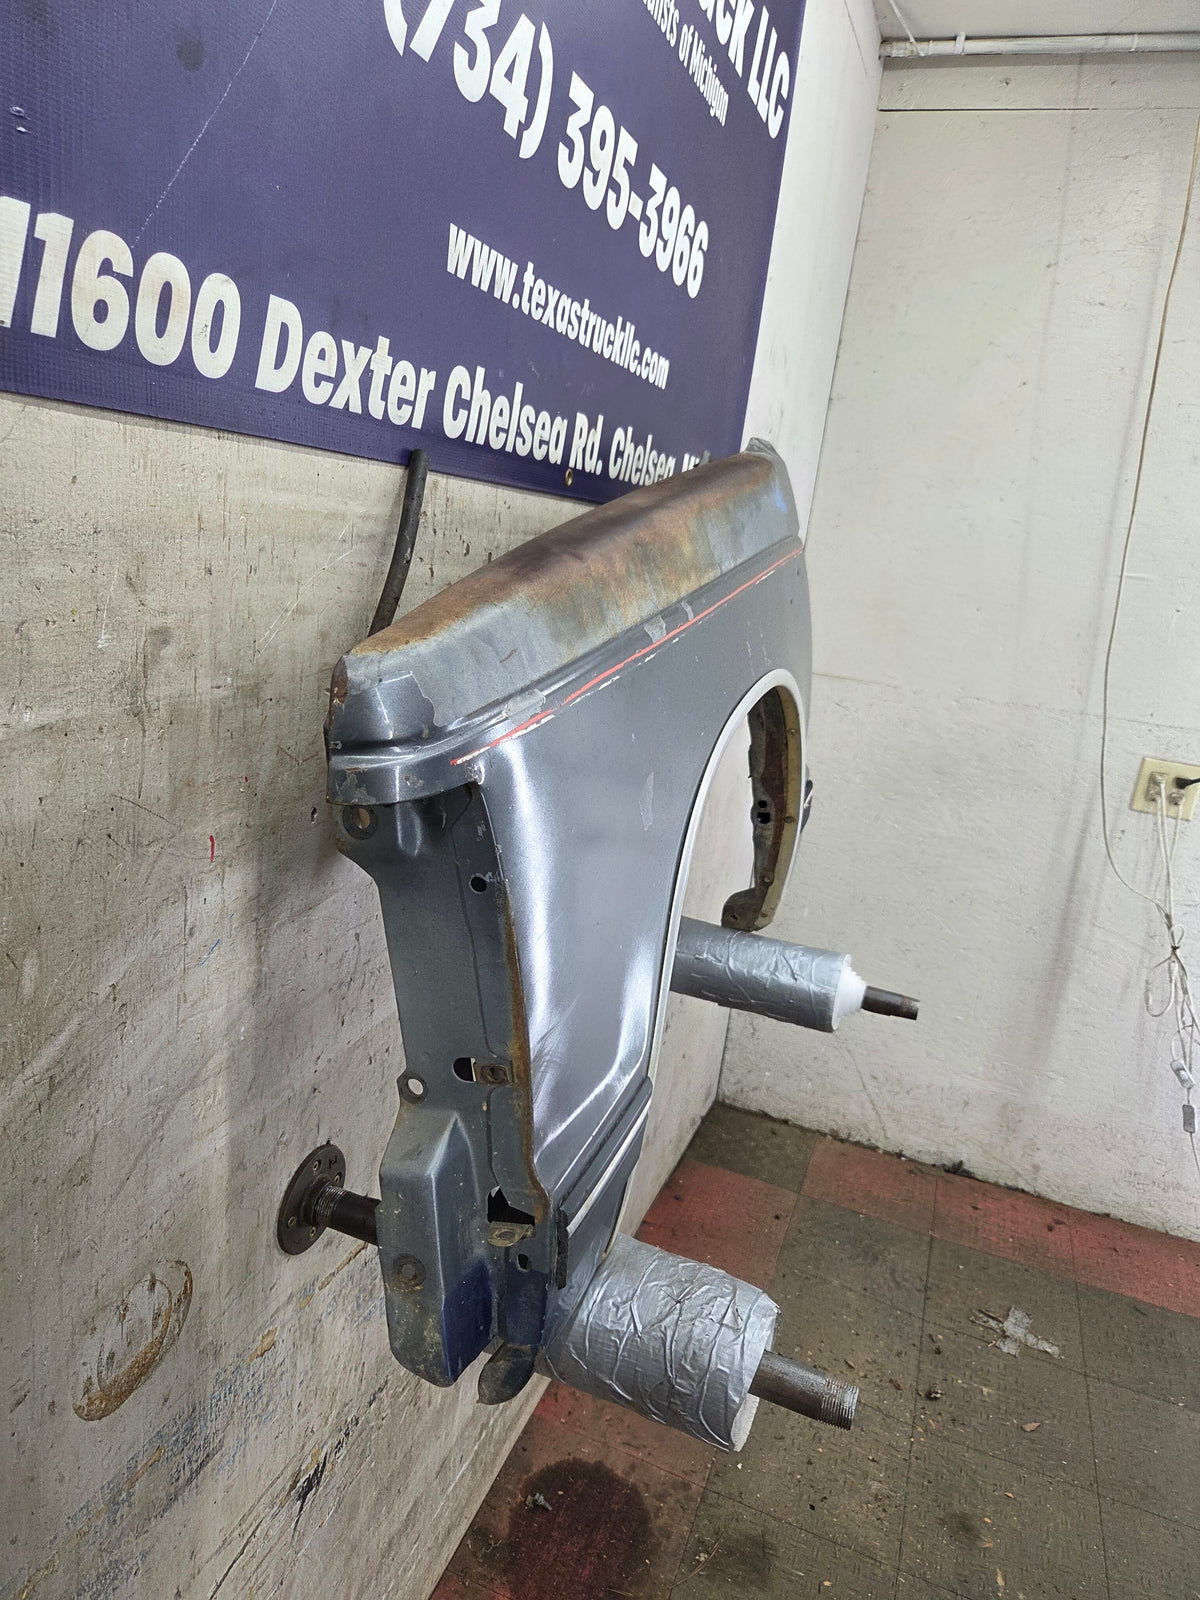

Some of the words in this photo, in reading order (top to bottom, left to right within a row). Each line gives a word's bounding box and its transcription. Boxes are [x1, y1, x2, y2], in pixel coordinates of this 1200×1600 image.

[679, 24, 695, 68] of
[689, 30, 729, 127] Michigan
[747, 5, 790, 139] LLC
[557, 71, 709, 299] 395-3966
[255, 294, 436, 429] Dexter
[443, 365, 568, 465] Chelsea
[569, 412, 604, 476] Rd.
[447, 223, 670, 389] www.texastruckllc.com
